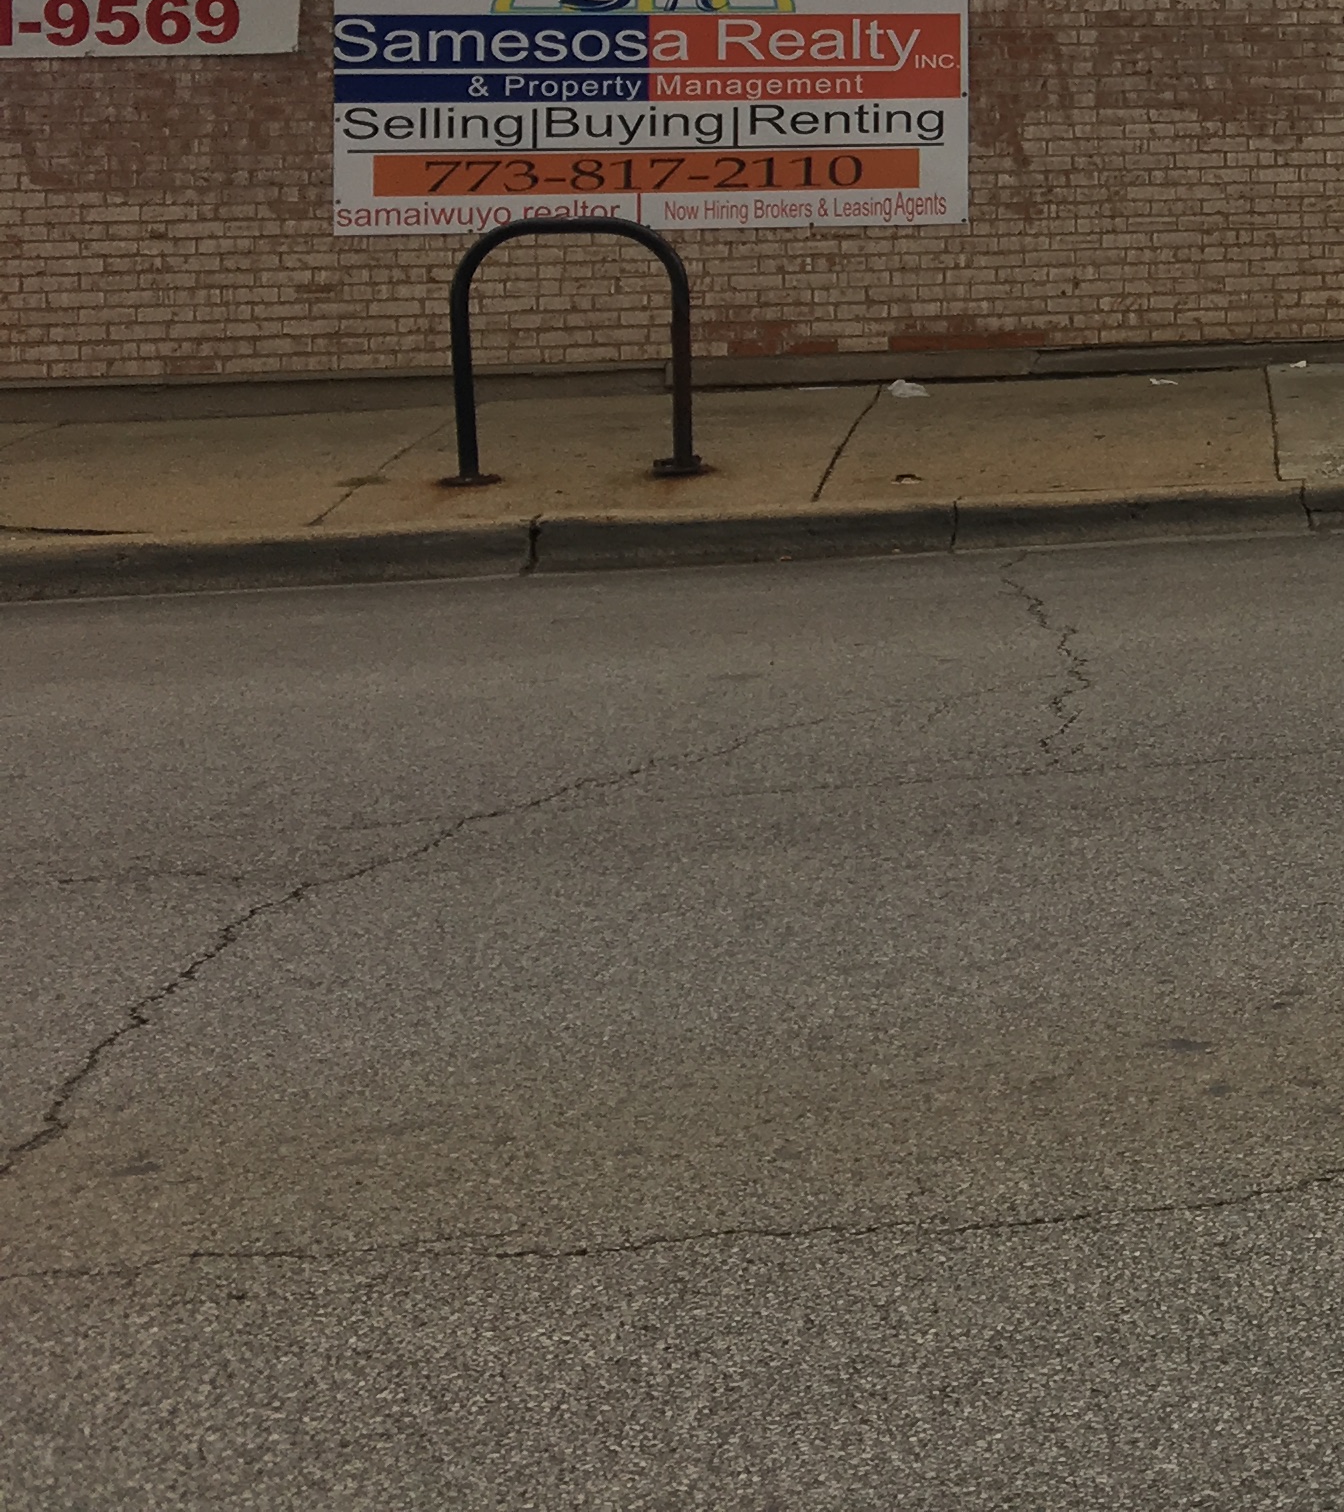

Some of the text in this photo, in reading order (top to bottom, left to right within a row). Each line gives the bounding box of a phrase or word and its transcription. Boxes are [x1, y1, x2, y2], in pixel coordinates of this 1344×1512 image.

[333, 18, 960, 71] Samesosa Realty INC.
[467, 74, 863, 101] & Property Management
[425, 155, 862, 193] 773-817-2110
[664, 191, 947, 224] Now Hiring Brokers & Leasing Agents
